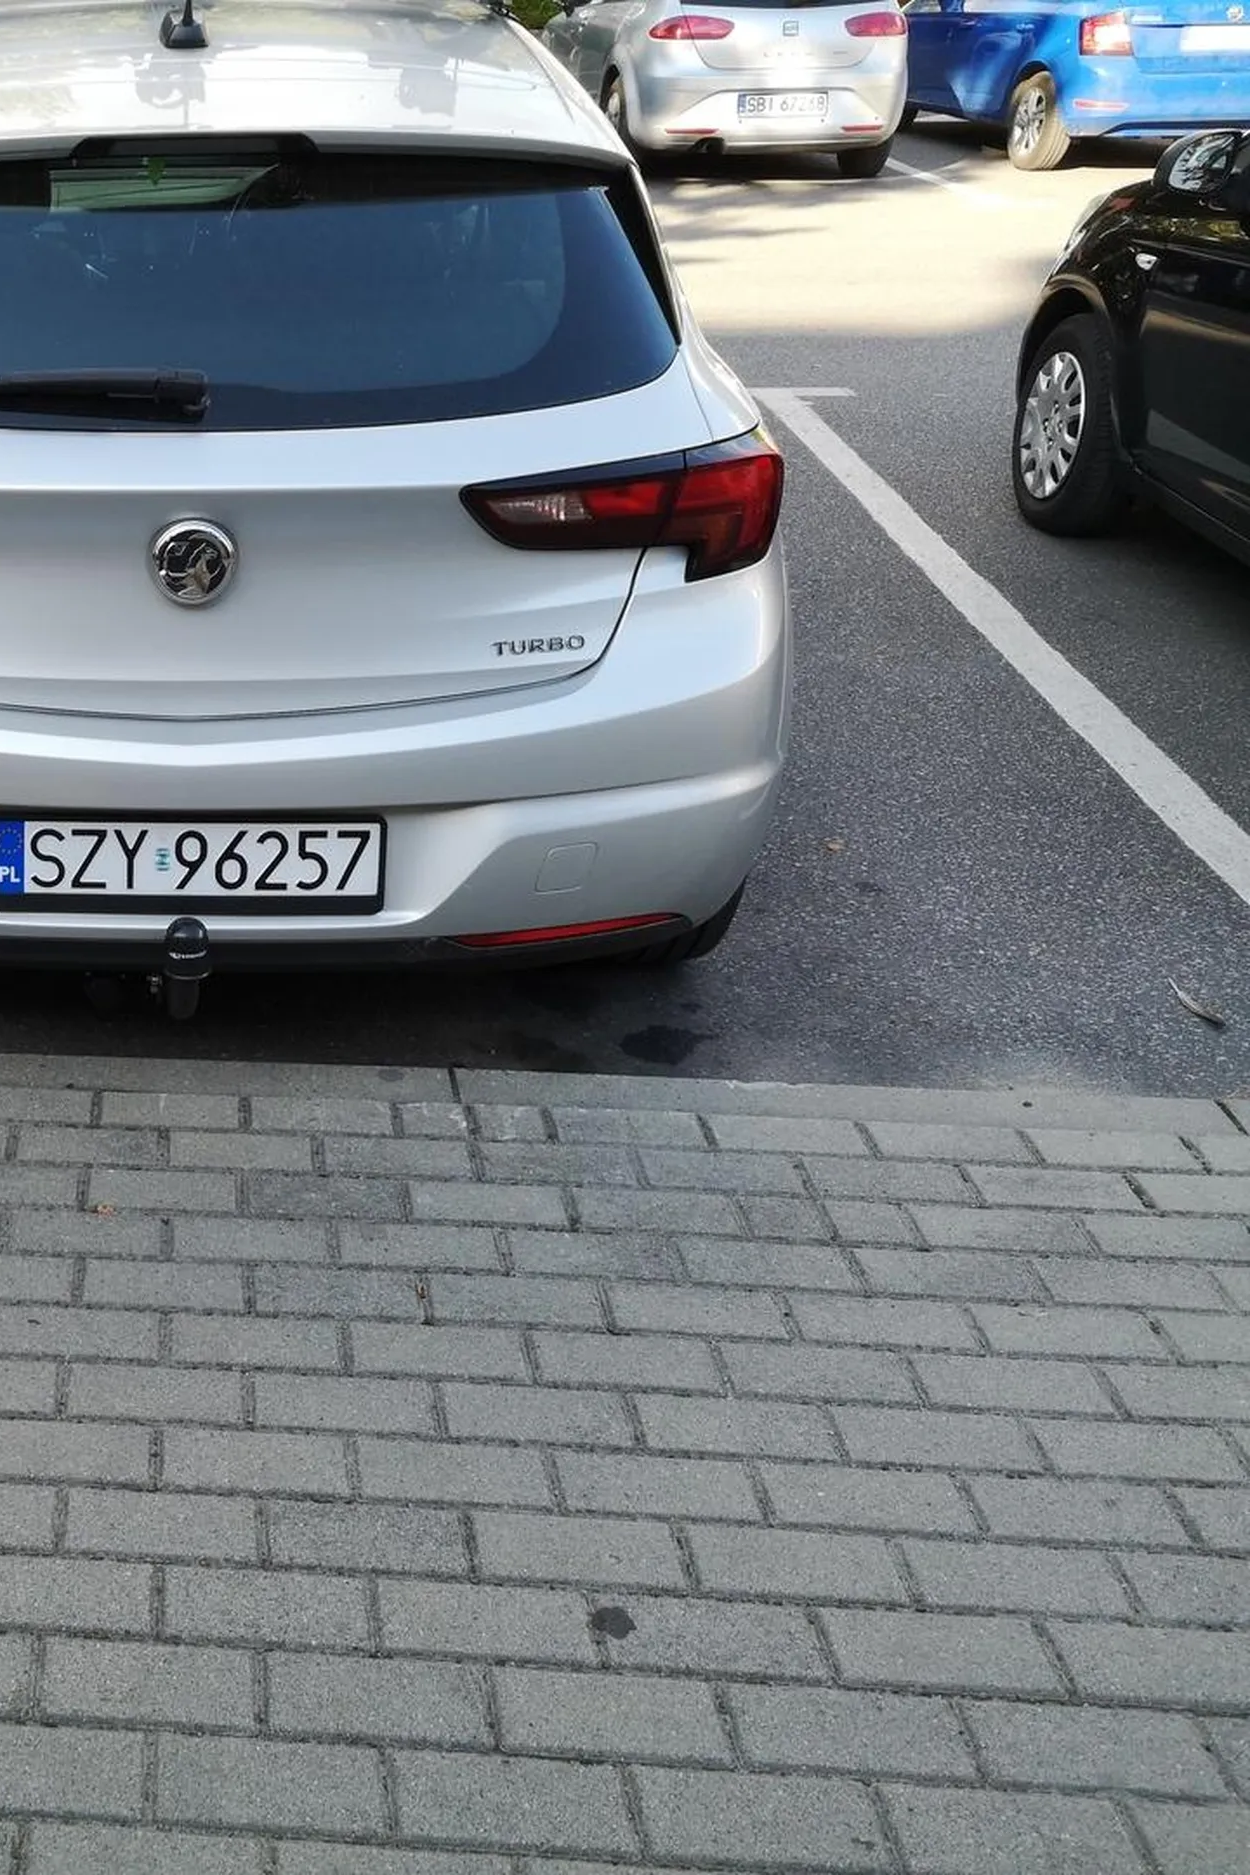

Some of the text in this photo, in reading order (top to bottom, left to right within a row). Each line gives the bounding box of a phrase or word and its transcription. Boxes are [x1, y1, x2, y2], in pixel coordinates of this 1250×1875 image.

[747, 97, 774, 113] SBI
[490, 635, 586, 656] TURBO
[30, 828, 372, 892] SZY 96257
